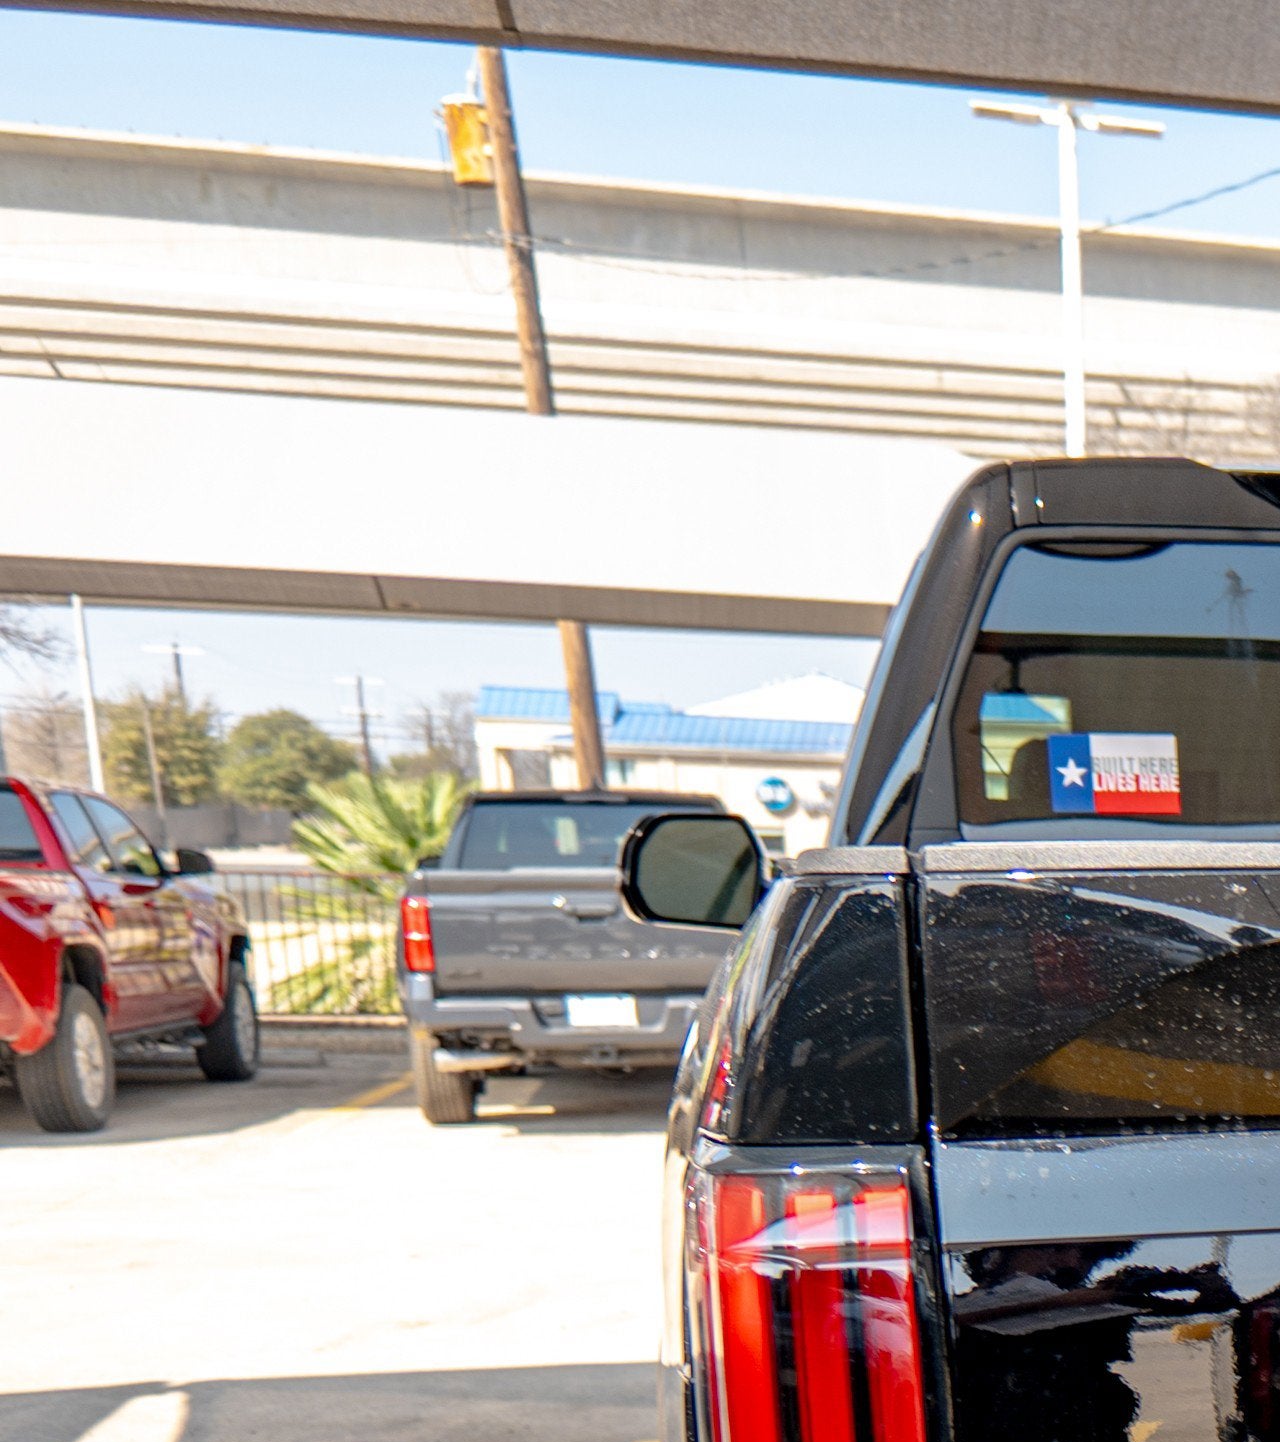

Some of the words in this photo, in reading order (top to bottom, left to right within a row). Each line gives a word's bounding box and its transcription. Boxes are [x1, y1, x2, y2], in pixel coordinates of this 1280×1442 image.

[1092, 756, 1135, 775] BUILT
[1138, 756, 1179, 775] HERE
[1094, 773, 1137, 792] LIVES
[1138, 773, 1180, 793] HERE
